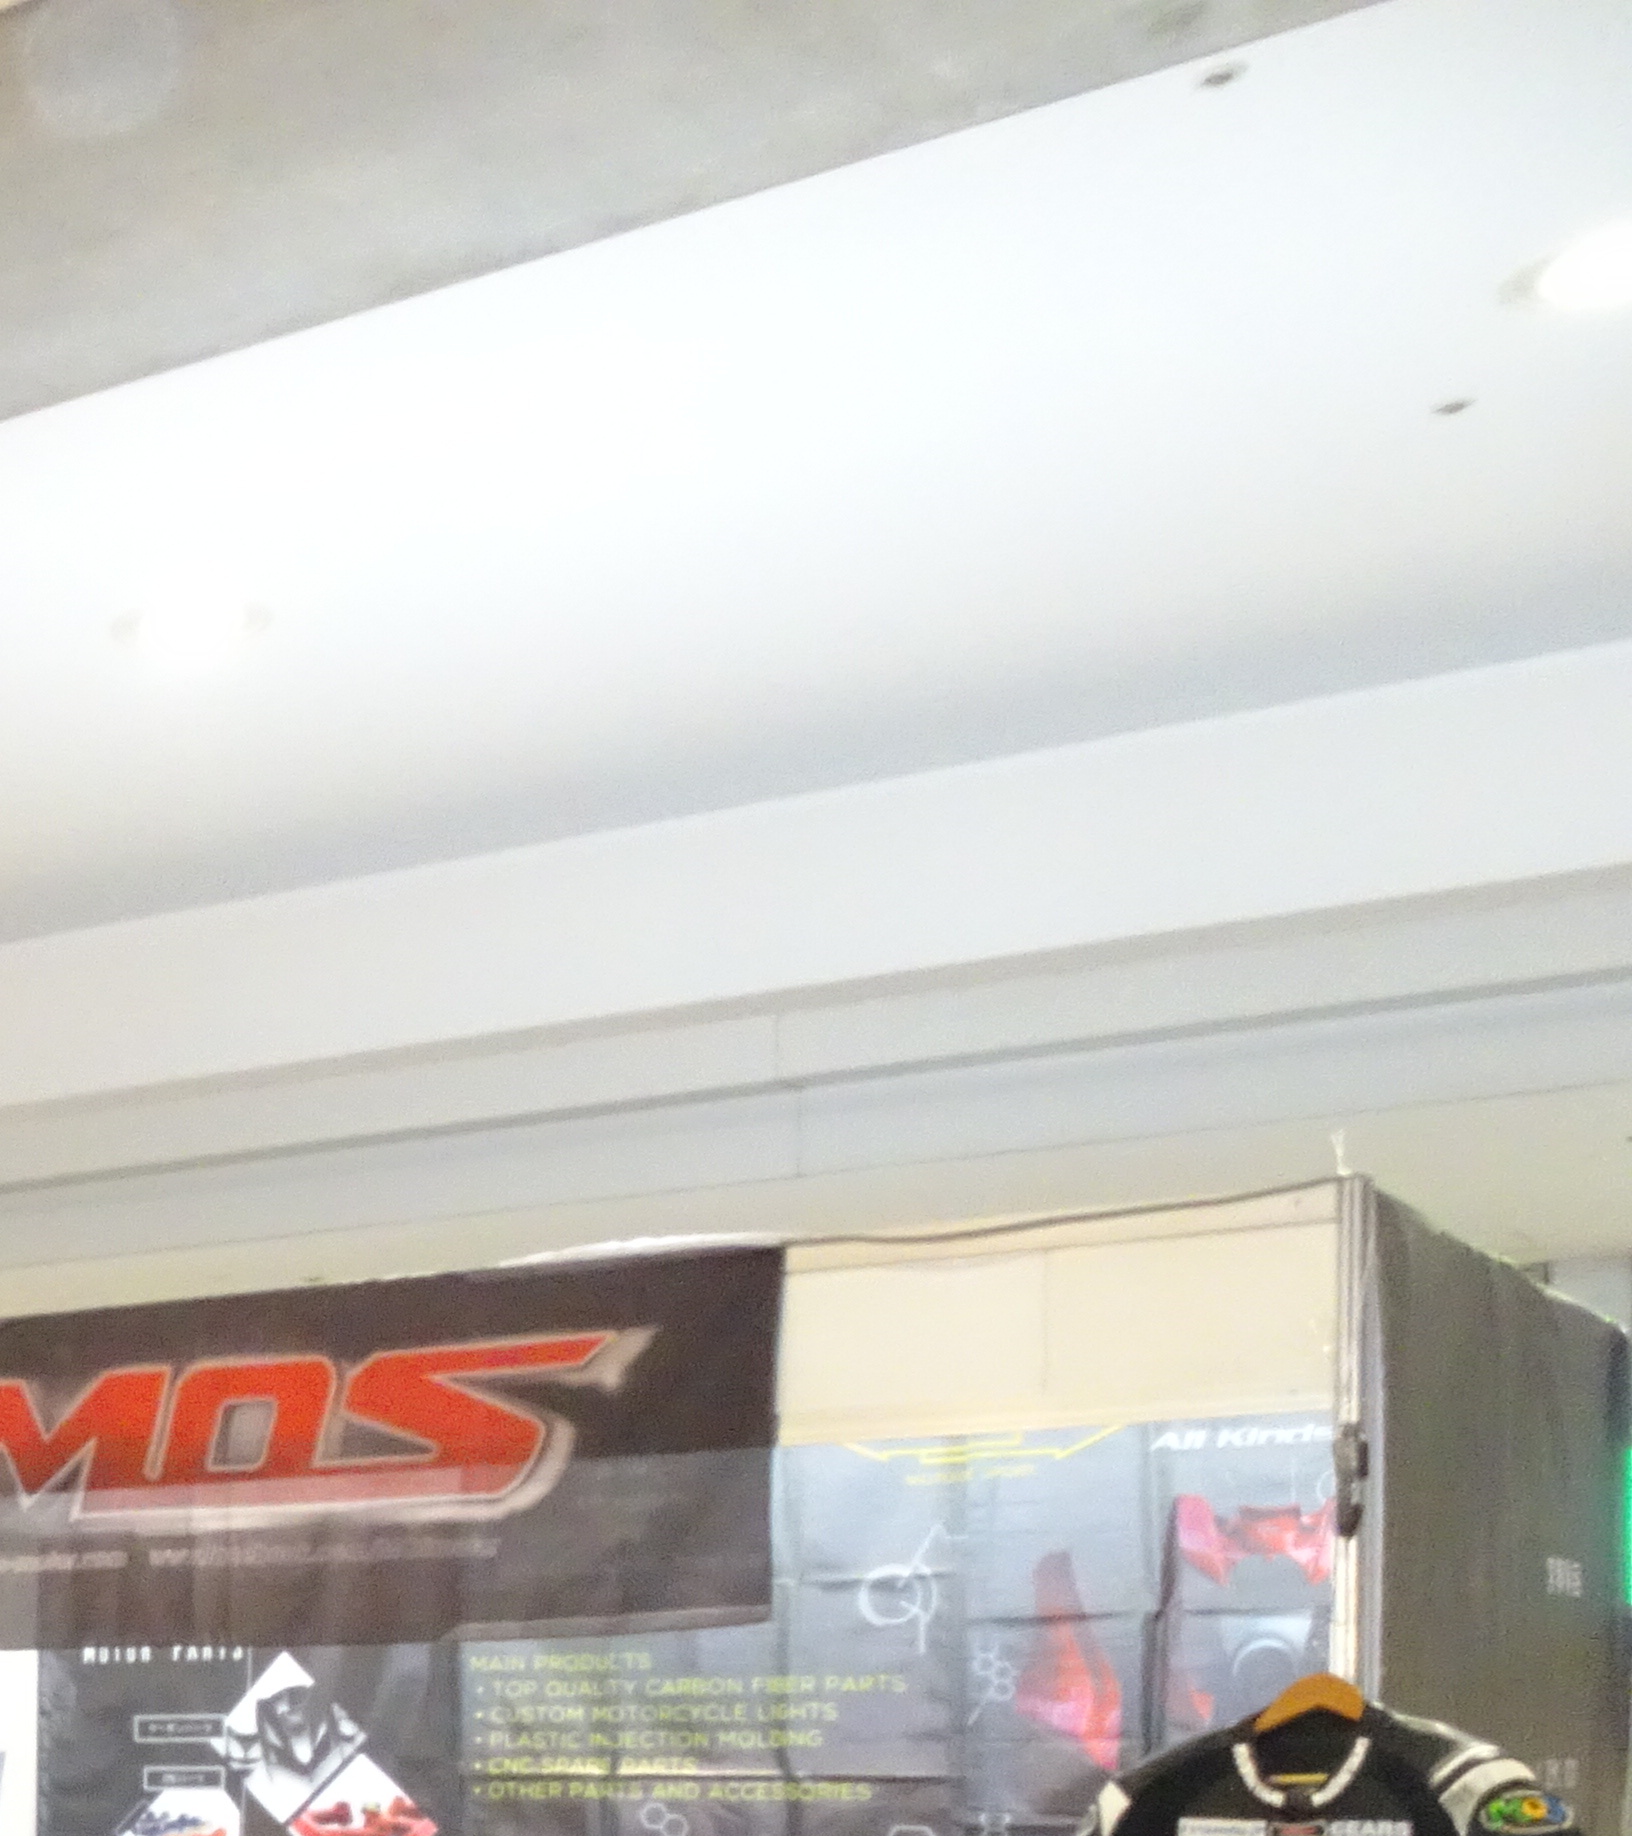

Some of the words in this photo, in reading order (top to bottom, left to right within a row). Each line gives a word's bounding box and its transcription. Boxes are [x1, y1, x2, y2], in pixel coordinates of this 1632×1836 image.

[470, 1655, 524, 1671] MAIN
[534, 1652, 652, 1670] PRODUCTS
[493, 1681, 535, 1697] TOP
[545, 1680, 636, 1697] QUALITY
[645, 1678, 742, 1695] CARBON
[750, 1676, 816, 1694] FIBER
[824, 1674, 906, 1693] PARTS
[489, 1706, 585, 1724] CUSTOM
[591, 1704, 748, 1723] MOTORCYCLE
[756, 1703, 838, 1722] LIGHTS
[488, 1731, 581, 1750] PLASTIC
[589, 1731, 710, 1749] INJECTION
[718, 1730, 824, 1749] MOLDING
[487, 1782, 564, 1801] OTHER
[569, 1782, 643, 1800] PARTS
[651, 1782, 702, 1800] AND
[711, 1782, 873, 1801] ACCESSORIES
